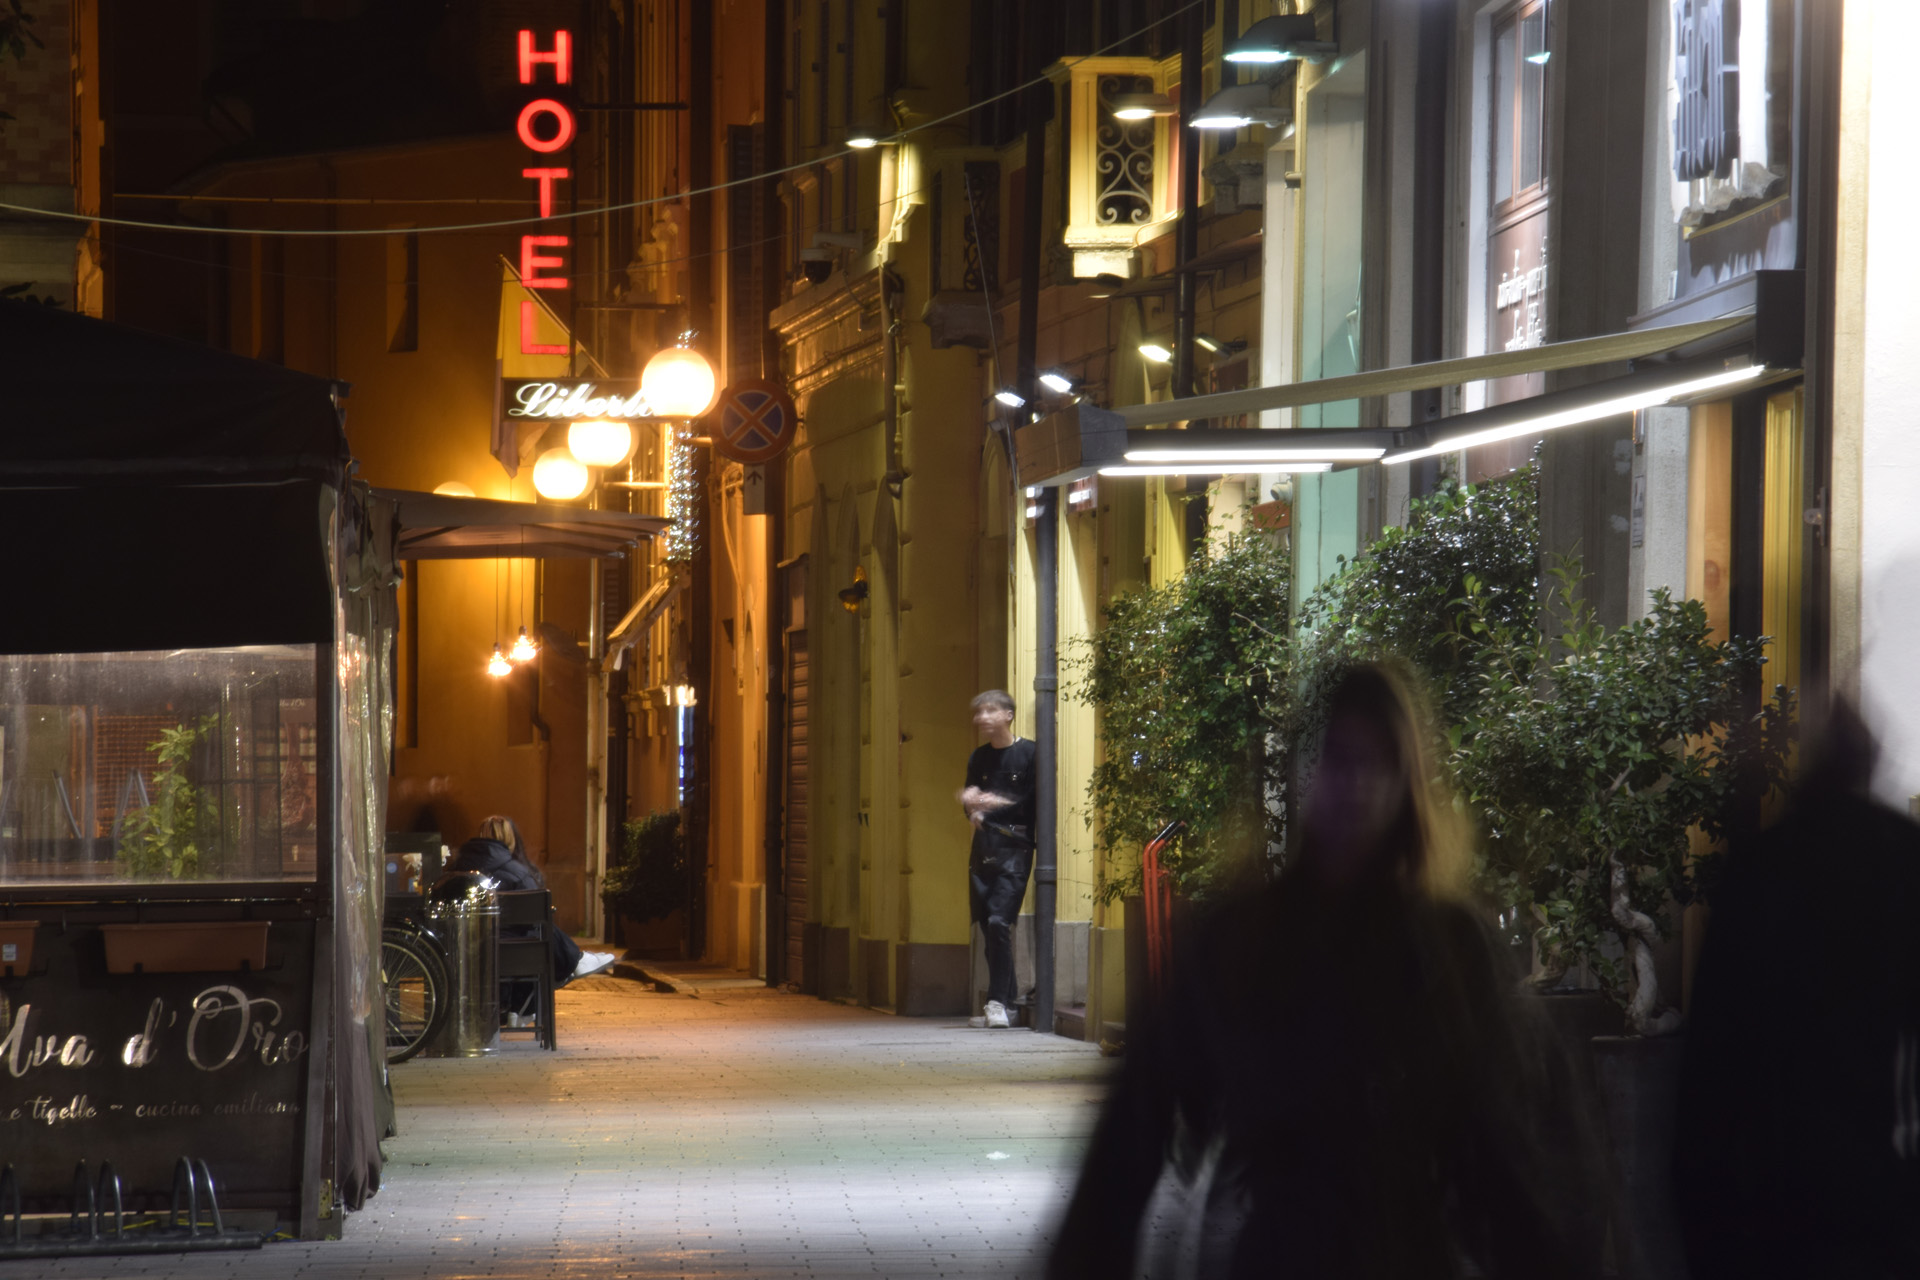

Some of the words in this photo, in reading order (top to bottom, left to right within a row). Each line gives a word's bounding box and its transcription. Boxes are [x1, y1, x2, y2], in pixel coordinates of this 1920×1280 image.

[517, 30, 573, 354] HOTEL
[508, 382, 660, 418] Libert
[122, 984, 308, 1071] d'Oro
[24, 1094, 97, 1125] tigelle
[135, 1101, 200, 1117] cucina
[213, 1091, 300, 1115] emiliana
